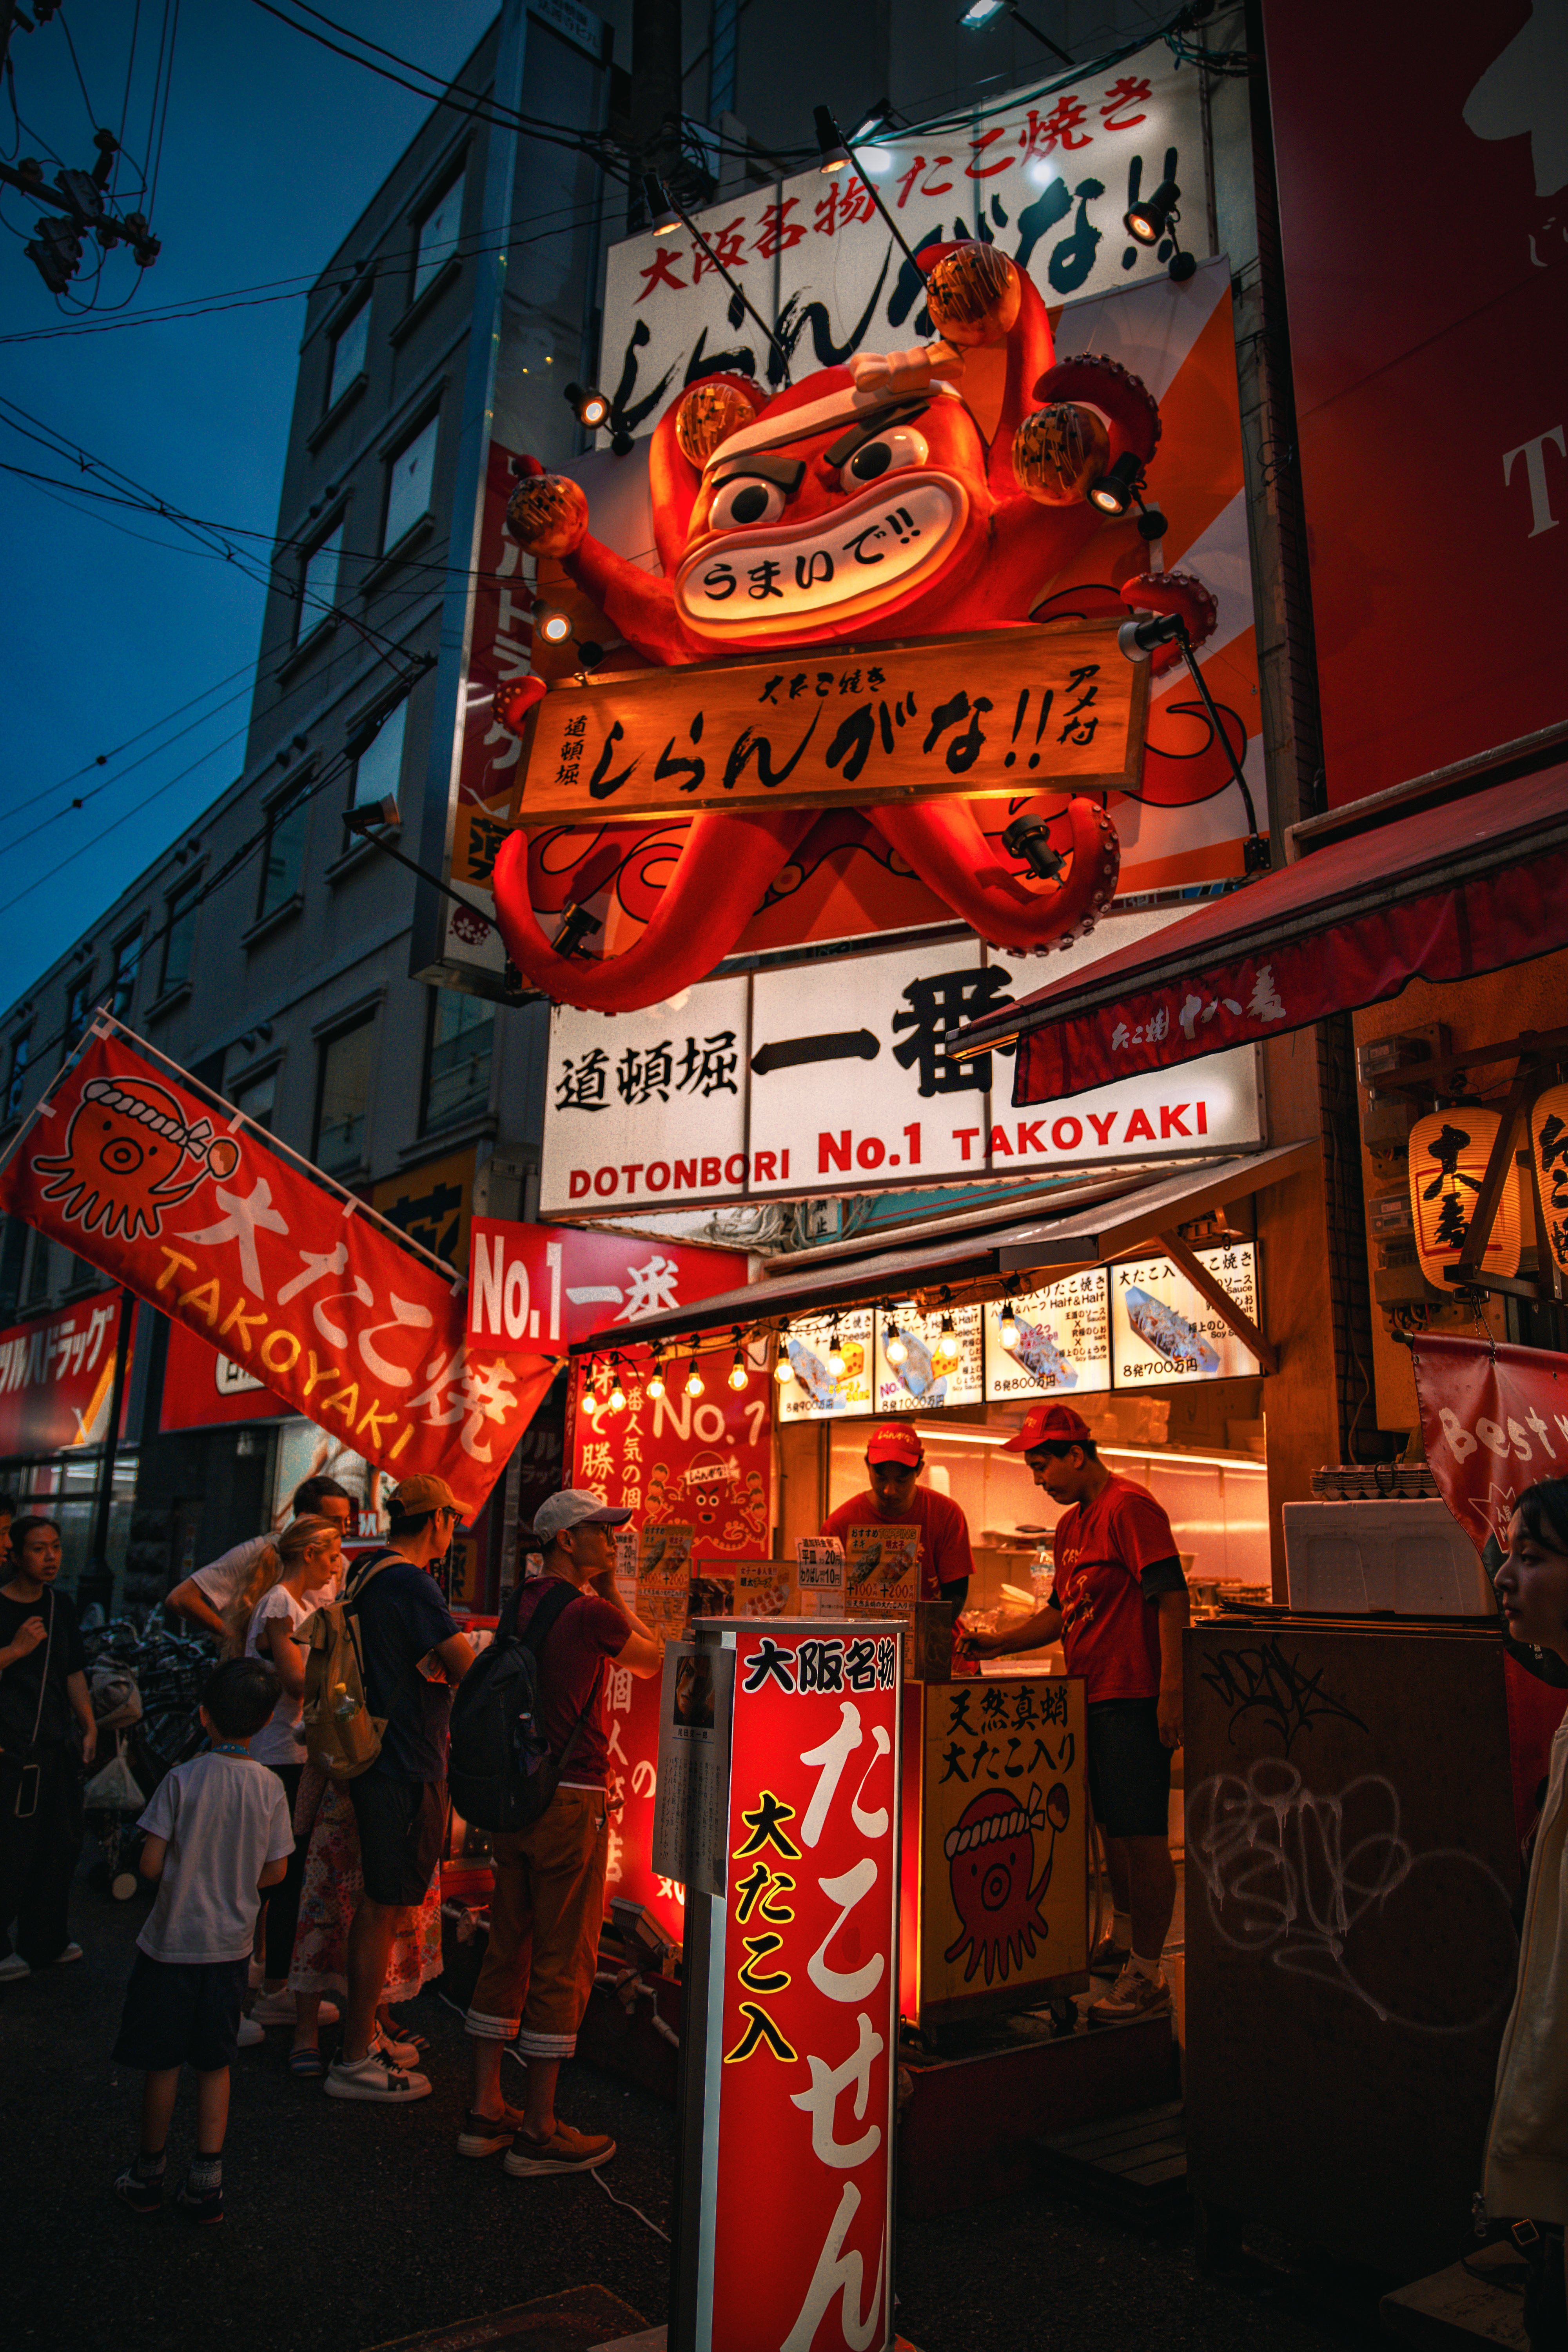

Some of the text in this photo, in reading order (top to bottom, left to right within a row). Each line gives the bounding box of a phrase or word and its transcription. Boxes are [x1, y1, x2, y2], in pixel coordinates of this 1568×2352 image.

[704, 506, 921, 602] うまいで!!
[759, 666, 887, 704] 大たこ焼き
[1058, 663, 1101, 746] アメ村
[554, 715, 587, 786] 道頓堀
[589, 688, 1054, 800] しらんがな!!
[554, 964, 1019, 1112] 道頓堀 一番
[568, 1101, 1208, 1200] DOTONBORI No.1 TAKOYAKI
[472, 1232, 563, 1341] No.1
[1119, 1252, 1252, 1286] 大たこ入こ焼き
[1227, 1285, 1252, 1294] Sauce
[156, 1245, 415, 1460] TAKOYAKI
[1210, 1330, 1227, 1339] Soy
[1123, 1358, 1198, 1377] 8発700万円
[652, 1392, 766, 1447] No.1
[1439, 1406, 1557, 1465] Best
[851, 1528, 878, 1538] おすすめ
[742, 1636, 897, 1696] 大阪名物
[678, 1728, 708, 1739] 尾田栄一郎
[946, 1685, 1069, 1737] 天然真蛸
[938, 1733, 1076, 1784] 大たこ入り
[723, 1789, 803, 2065] 大たこ入
[778, 1700, 892, 2352] たこせん
